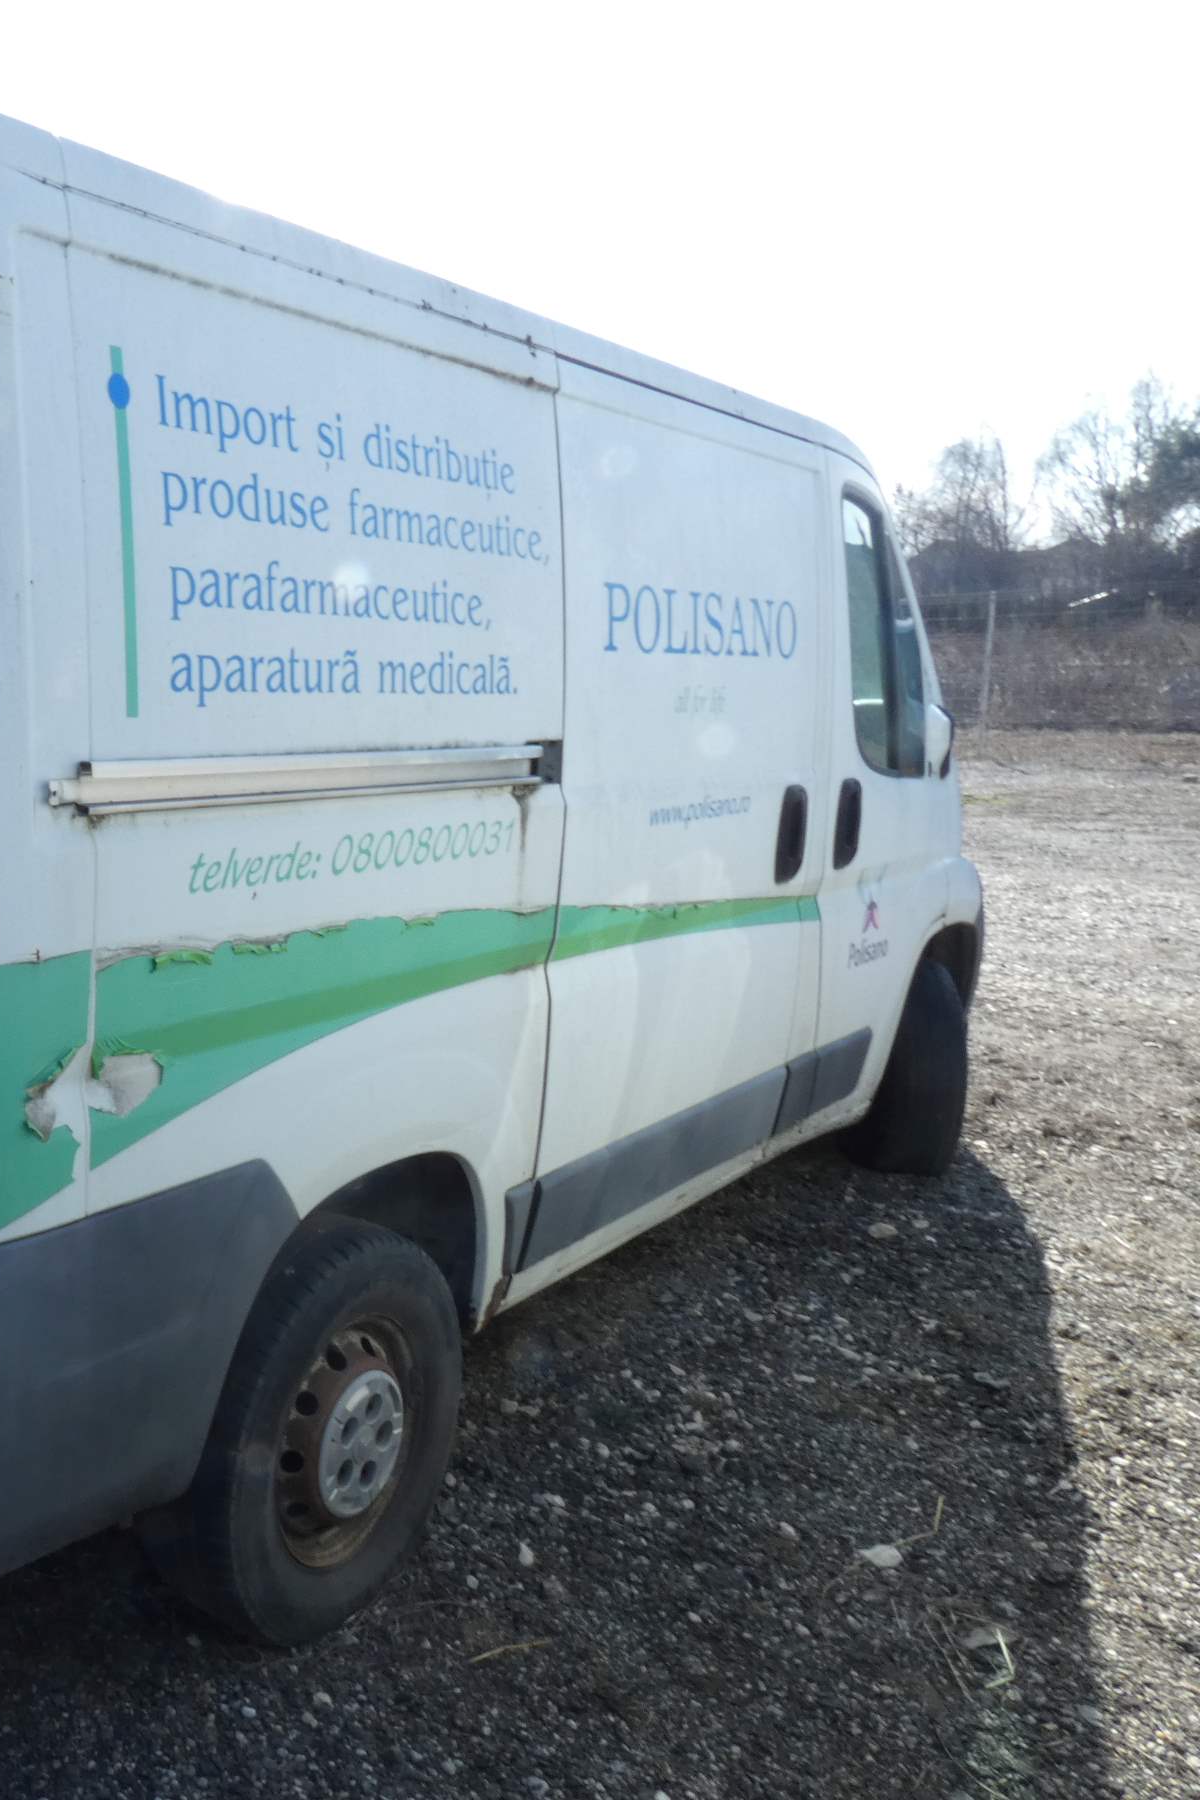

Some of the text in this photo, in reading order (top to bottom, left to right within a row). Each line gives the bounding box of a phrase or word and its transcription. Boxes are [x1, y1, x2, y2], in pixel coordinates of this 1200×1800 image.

[155, 373, 299, 453] Import
[160, 470, 550, 566] produse farmaceutice,
[169, 560, 492, 631] parafarmaceutice,
[602, 581, 798, 660] POLISANO
[187, 816, 516, 895] telverde: 0800800031
